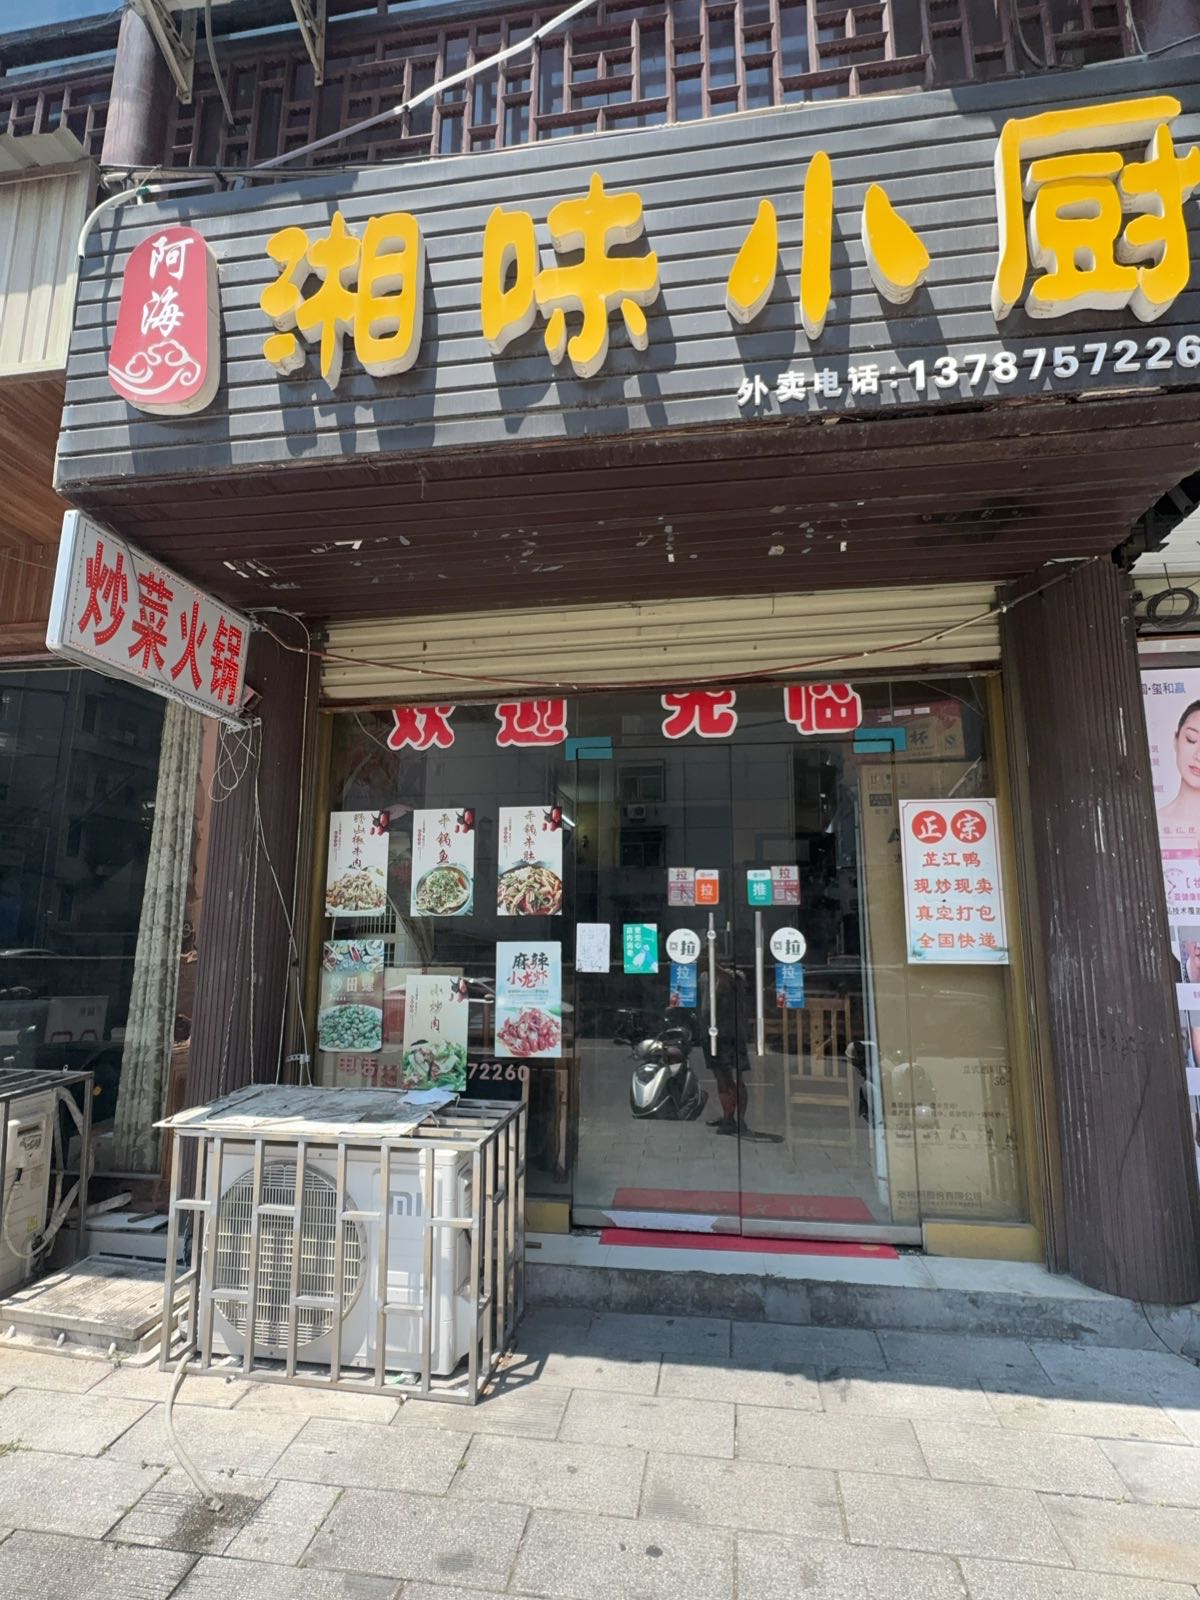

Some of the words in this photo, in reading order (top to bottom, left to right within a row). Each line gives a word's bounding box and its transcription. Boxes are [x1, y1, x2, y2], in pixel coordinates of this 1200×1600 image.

[259, 96, 1200, 384] 湘味小厨
[141, 236, 194, 337] 阿海
[78, 540, 242, 706] 炒菜火锅
[918, 813, 980, 840] 正宗
[922, 851, 981, 867] 芷江鸭
[676, 869, 688, 880] 拉
[779, 867, 791, 879] 拉
[701, 883, 713, 896] 拉
[753, 882, 767, 896] 推
[914, 878, 993, 895] 现炒现卖
[915, 905, 995, 922] 真空打包
[917, 932, 998, 949] 全国快递
[511, 952, 550, 970] 麻辣
[506, 970, 548, 988] 小龙虾
[676, 966, 690, 979] 拉
[782, 965, 796, 979] 拉
[468, 1063, 529, 1080] 72260
